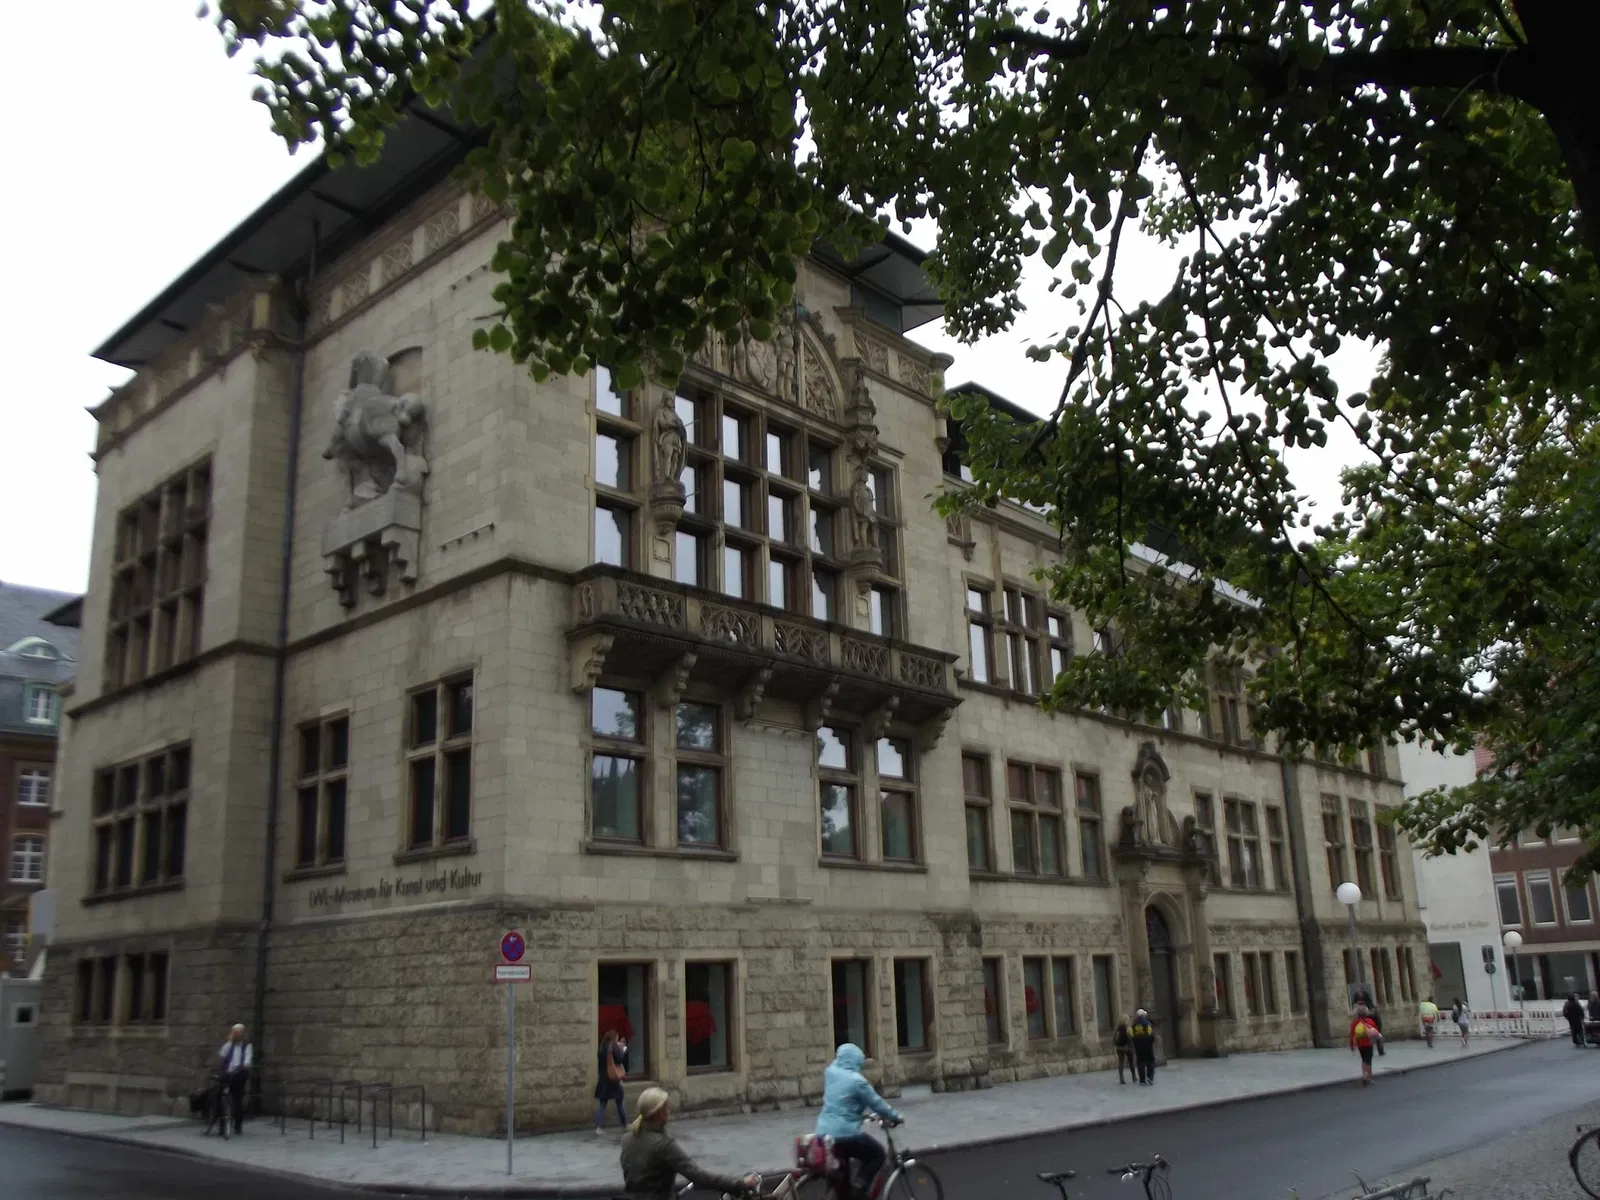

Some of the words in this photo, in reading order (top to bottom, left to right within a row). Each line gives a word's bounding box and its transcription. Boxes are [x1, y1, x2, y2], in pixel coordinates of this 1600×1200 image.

[396, 877, 422, 895] Kunst
[425, 869, 446, 892] und
[450, 865, 482, 889] Kultur
